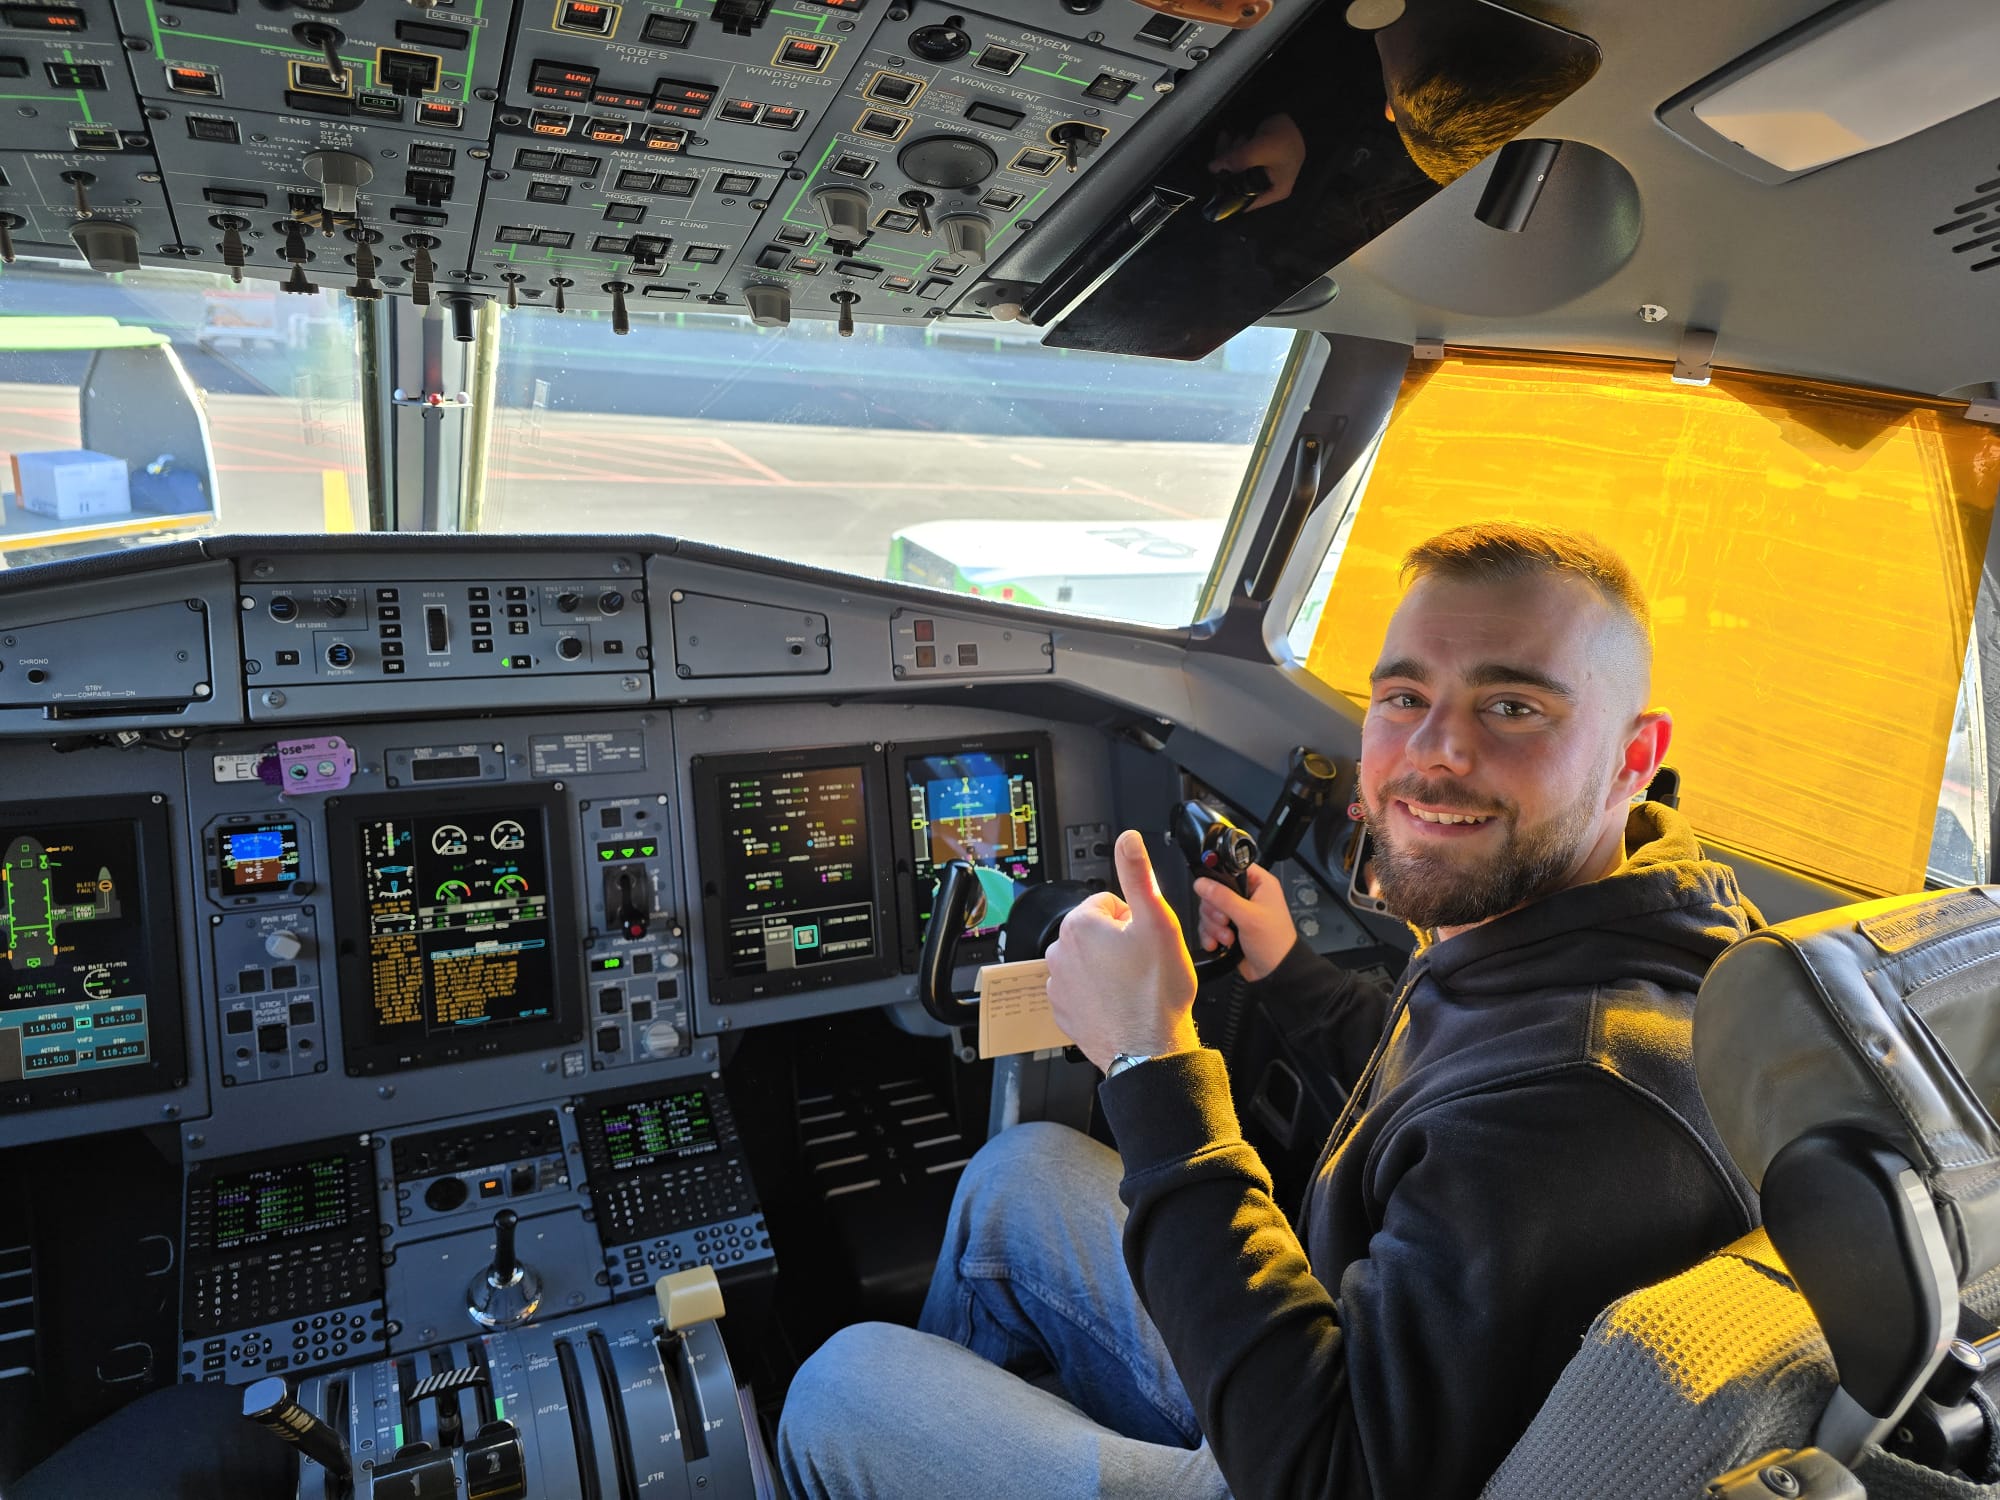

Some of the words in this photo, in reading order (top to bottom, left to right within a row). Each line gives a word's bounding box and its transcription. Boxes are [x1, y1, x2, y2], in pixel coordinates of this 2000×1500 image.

[573, 3, 599, 13] FAULT
[651, 6, 671, 15] EXT
[676, 9, 699, 18] PWR
[800, 4, 821, 14] ACW
[826, 8, 847, 18] BUS
[320, 16, 342, 25] SEL
[432, 11, 448, 20] DC
[452, 14, 472, 23] BUS
[255, 23, 289, 34] EMER
[786, 29, 809, 38] ACW
[813, 33, 834, 42] GEN
[349, 38, 377, 48] MAIN
[794, 41, 817, 51] FAULT
[984, 32, 1008, 44] MAIN
[1009, 39, 1042, 54] SUPPLY
[1021, 32, 1073, 52] OXYGEN
[605, 43, 670, 61] PROBES
[620, 55, 650, 65] HTG
[1057, 53, 1084, 63] CREW
[863, 61, 903, 76] EXHAUST
[905, 71, 930, 82] MODE
[1099, 63, 1118, 75] PAX
[1118, 67, 1150, 82] SUPPLY
[564, 73, 592, 83] ALPHA
[746, 66, 833, 88] WINDSHIELD
[771, 79, 799, 89] HTG
[534, 85, 557, 95] PITOT
[564, 88, 583, 98] STAT
[951, 75, 1007, 95] AVIONICS
[1011, 88, 1041, 104] VENT
[597, 95, 619, 105] PITOT
[625, 98, 643, 107] STAT
[685, 91, 710, 101] ALPHA
[542, 104, 568, 112] CAPT
[655, 103, 677, 112] PITOT
[683, 106, 701, 115] STAT
[772, 106, 793, 115] FAULT
[189, 111, 219, 120] START
[278, 116, 312, 126] ENG
[319, 121, 369, 133] START
[320, 130, 342, 138] OFF
[934, 121, 973, 136] COMPT
[977, 131, 1008, 143] TEMP
[275, 137, 311, 145] CRANK
[320, 134, 352, 143] START
[411, 139, 446, 147] START
[843, 135, 858, 144] FLT
[859, 138, 886, 149] COMPT
[249, 143, 282, 151] START
[320, 140, 354, 148] ABORT
[246, 150, 279, 158] START
[547, 147, 577, 156] PROP
[33, 153, 65, 161] MIN
[72, 154, 107, 162] CAB
[611, 151, 640, 161] ANTI
[643, 154, 676, 164] ICING
[63, 160, 81, 168] LT
[276, 185, 316, 194] PROP
[605, 192, 633, 200] MODE
[207, 208, 249, 217] BEACON
[680, 222, 709, 230] ICING
[77, 690, 111, 698] COMPASS
[24, 990, 37, 999] ALT
[75, 1003, 90, 1011] VHF1
[32, 1055, 70, 1067] 121.500
[631, 1378, 652, 1390] AUTO
[537, 1403, 559, 1416] AUTO
[486, 1452, 501, 1475] 2
[647, 1472, 665, 1483] FTR
[410, 1471, 421, 1496] 1
